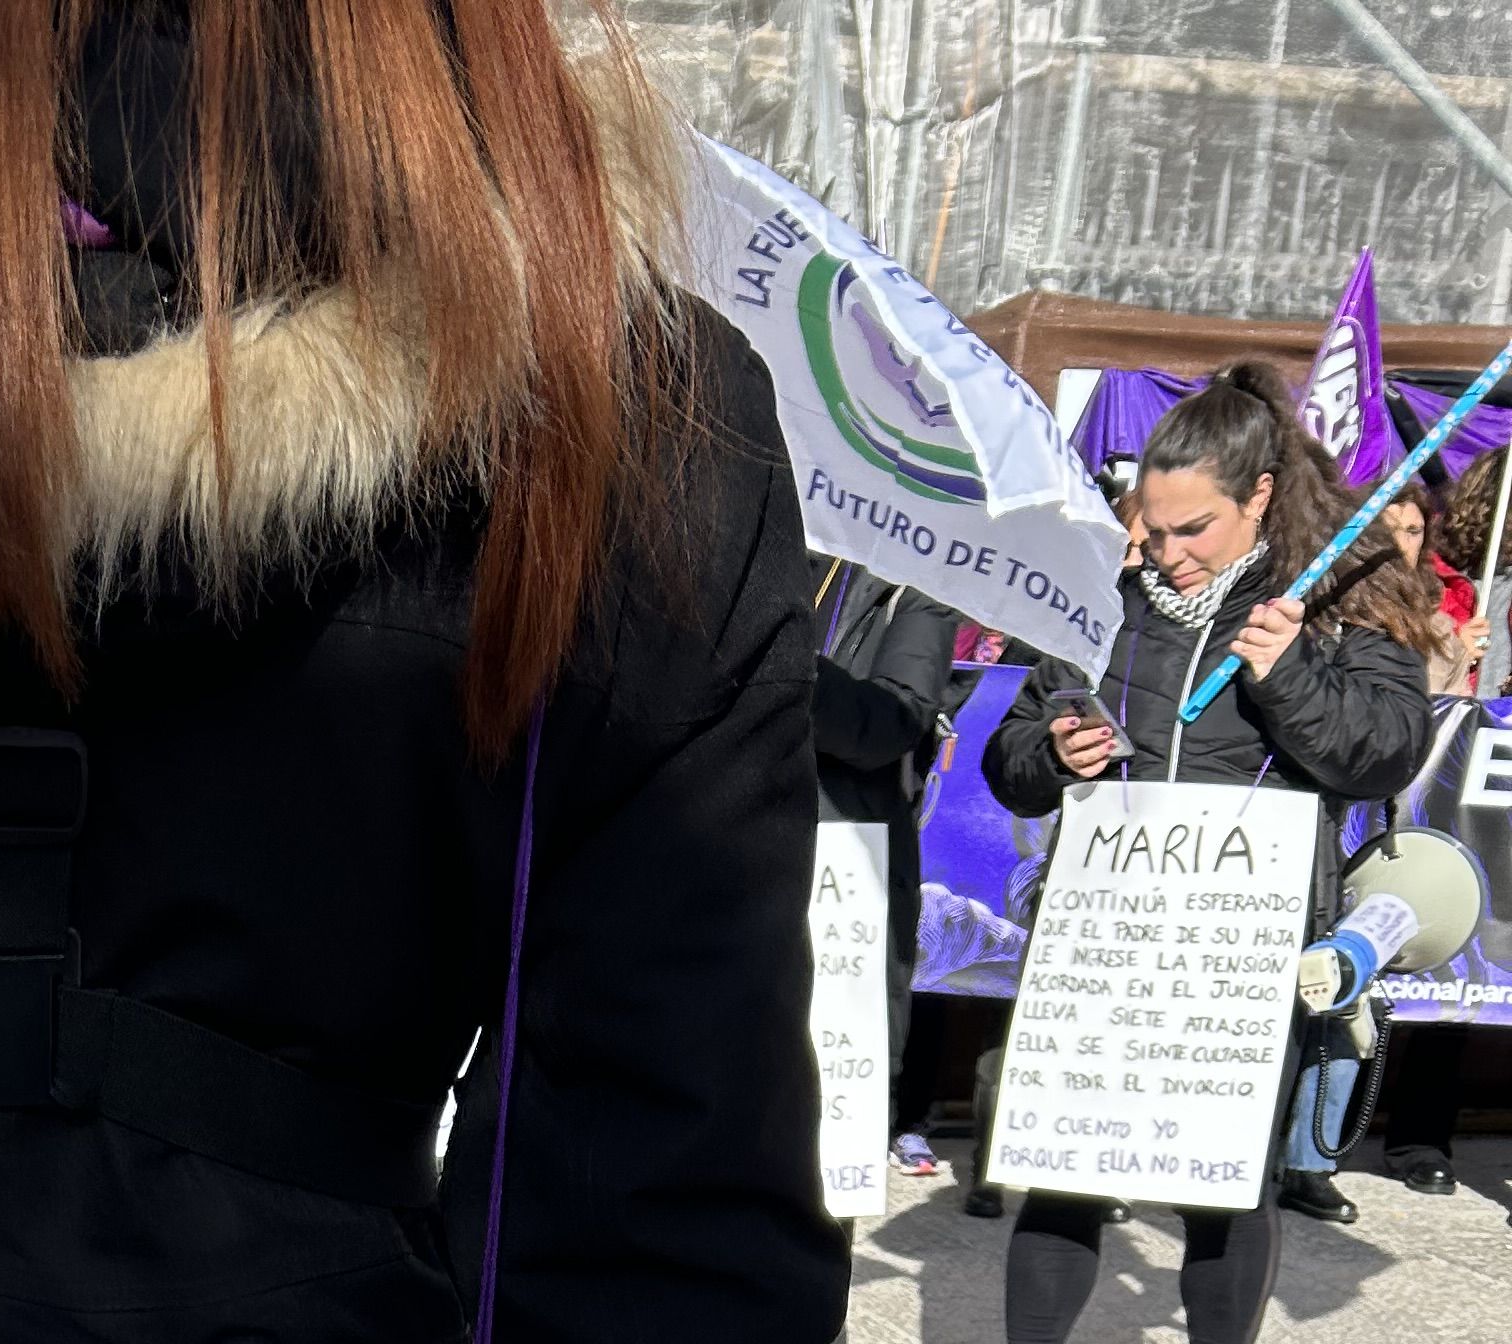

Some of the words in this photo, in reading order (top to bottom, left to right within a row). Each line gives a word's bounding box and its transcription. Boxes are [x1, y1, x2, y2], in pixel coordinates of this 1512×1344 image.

[735, 267, 776, 309] LA
[806, 468, 936, 557] FUTURO
[945, 539, 998, 577] DE
[1003, 557, 1106, 647] TODAS
[1048, 886, 1167, 914] CONTINÚA
[1184, 892, 1303, 913] ESPERANDO
[824, 923, 841, 941] A
[851, 920, 878, 945] SU
[1040, 917, 1070, 937] QUE
[1080, 919, 1102, 939] EL
[1113, 921, 1165, 942] PADRE
[1176, 925, 1201, 944] DE
[1210, 927, 1240, 945] SU
[1253, 926, 1296, 948] HIJA
[1034, 944, 1055, 965] LE
[1156, 951, 1188, 971] LA
[1028, 972, 1113, 998] ACORDADA
[1127, 978, 1154, 998] EN
[1171, 980, 1196, 999] EL
[1022, 1000, 1078, 1022] LLEVA
[1108, 1006, 1166, 1028] SIETE
[1181, 1016, 1278, 1038] ATRASOS.
[822, 1030, 853, 1048] DA
[1016, 1032, 1058, 1053] ELLA
[1077, 1036, 1104, 1055] SE
[1123, 1039, 1188, 1061] SIENTE
[1191, 1045, 1274, 1063] CULPABLE
[1008, 1067, 1044, 1087] POR
[1063, 1070, 1107, 1091] PEDIR
[1123, 1073, 1145, 1093] EL
[1162, 1075, 1255, 1099] DIVORCIO.
[1008, 1110, 1037, 1130] LO
[1053, 1116, 1132, 1139] CUENTO
[1153, 1118, 1179, 1140] YO
[999, 1145, 1079, 1171] PORQUE
[1098, 1150, 1142, 1174] ELLA
[1149, 1153, 1180, 1175] NO
